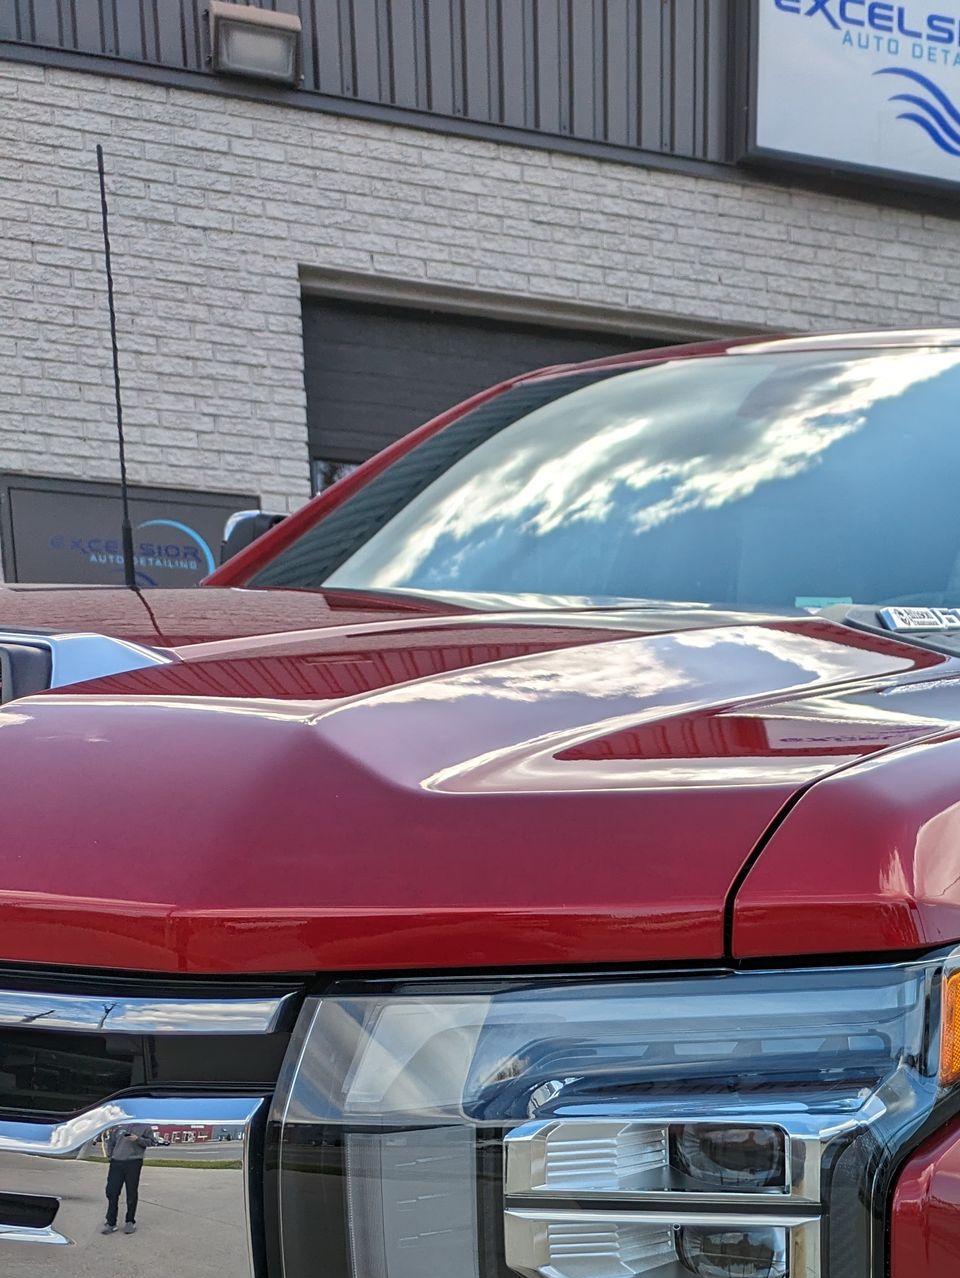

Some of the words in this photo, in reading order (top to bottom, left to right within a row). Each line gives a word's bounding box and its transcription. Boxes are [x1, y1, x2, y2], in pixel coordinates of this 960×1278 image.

[842, 30, 899, 55] AUTO
[50, 536, 202, 562] EXCESIOR
[90, 554, 125, 565] AUTO
